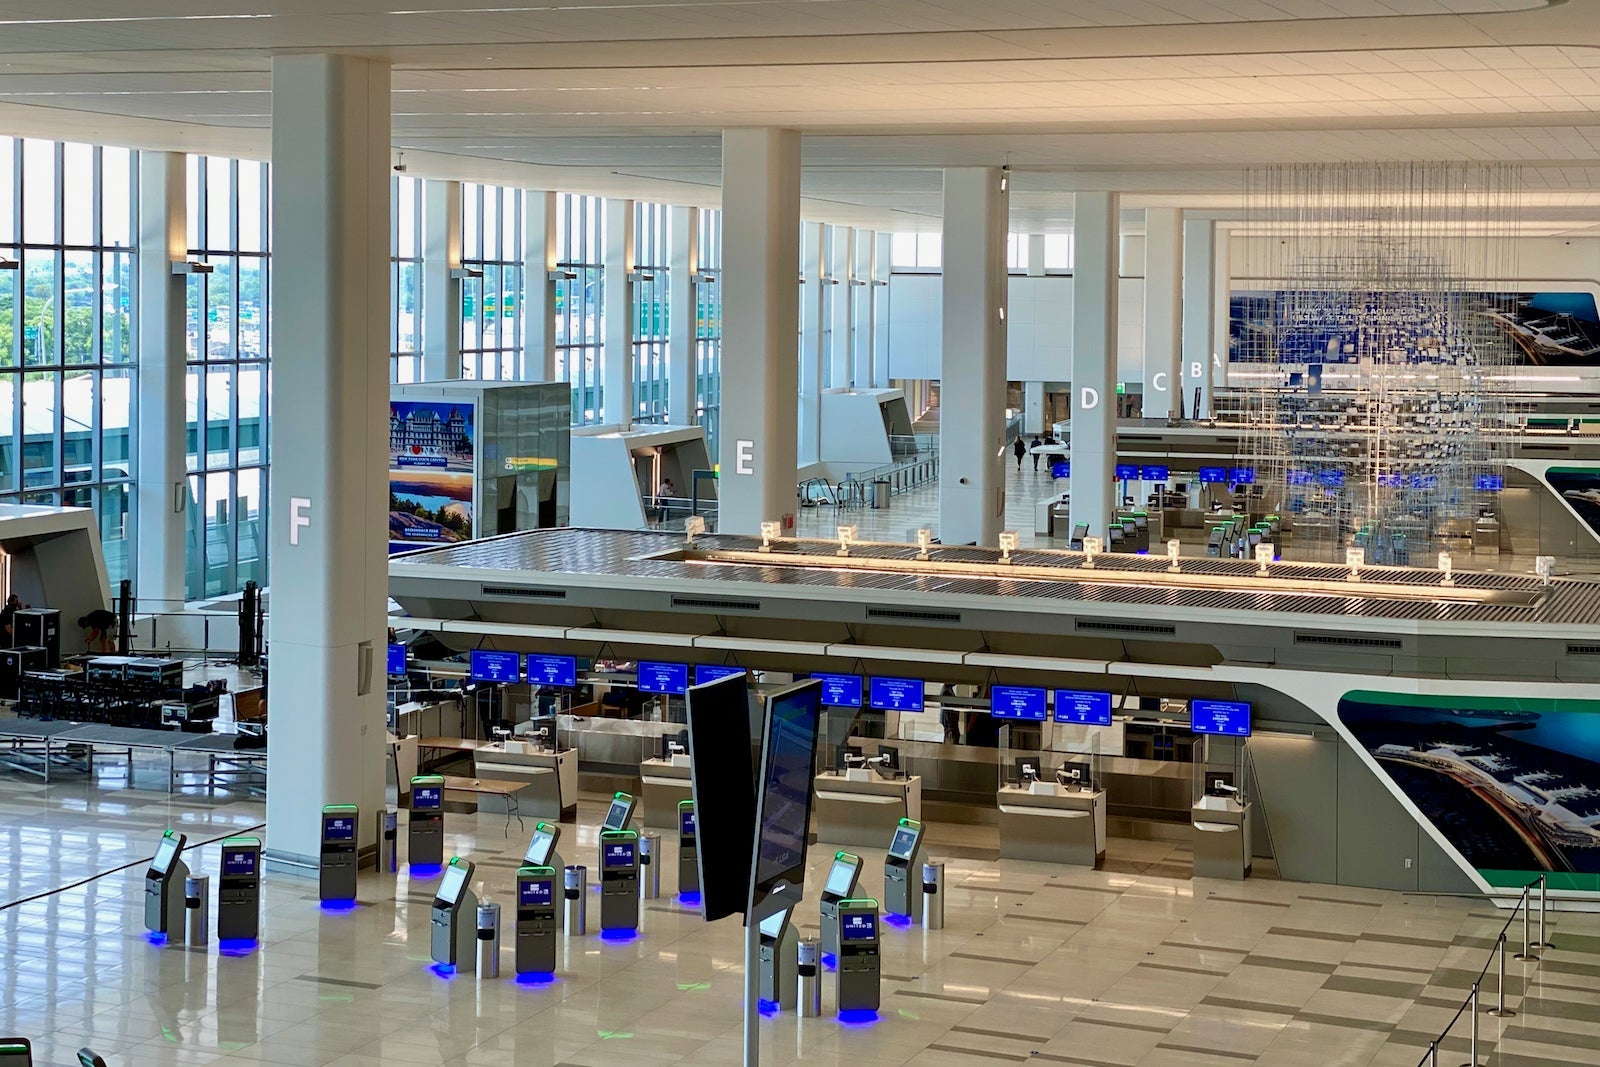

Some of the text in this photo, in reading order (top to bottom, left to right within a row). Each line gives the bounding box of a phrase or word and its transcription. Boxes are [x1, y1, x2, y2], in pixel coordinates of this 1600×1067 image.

[1191, 362, 1203, 378] B
[1213, 353, 1221, 368] A
[1152, 372, 1167, 392] C
[1081, 387, 1099, 409] D
[421, 446, 442, 457] NY
[737, 441, 753, 474] E
[290, 497, 311, 546] F
